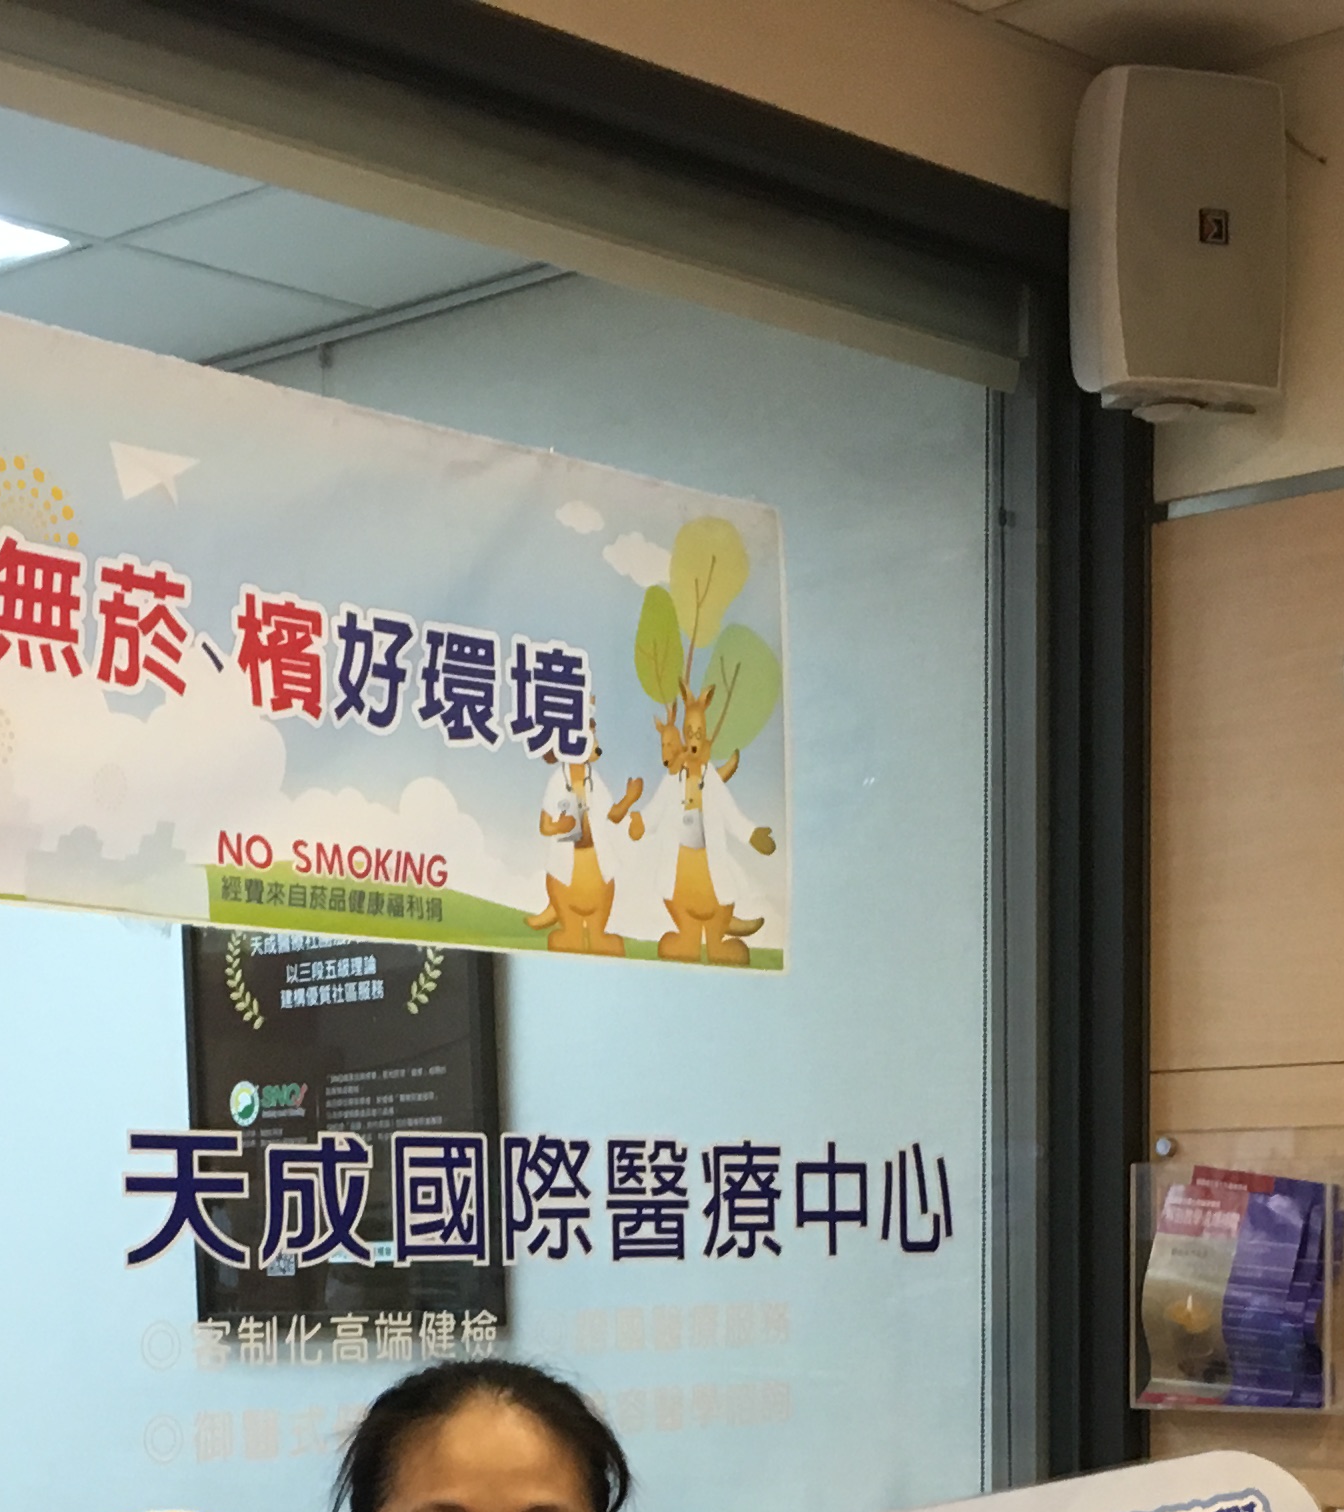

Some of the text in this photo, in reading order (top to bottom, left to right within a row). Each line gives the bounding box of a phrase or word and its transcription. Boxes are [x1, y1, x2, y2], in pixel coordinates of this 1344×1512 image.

[217, 829, 450, 889] NO SMOKING
[124, 1133, 954, 1265] 天成國際醫療中心
